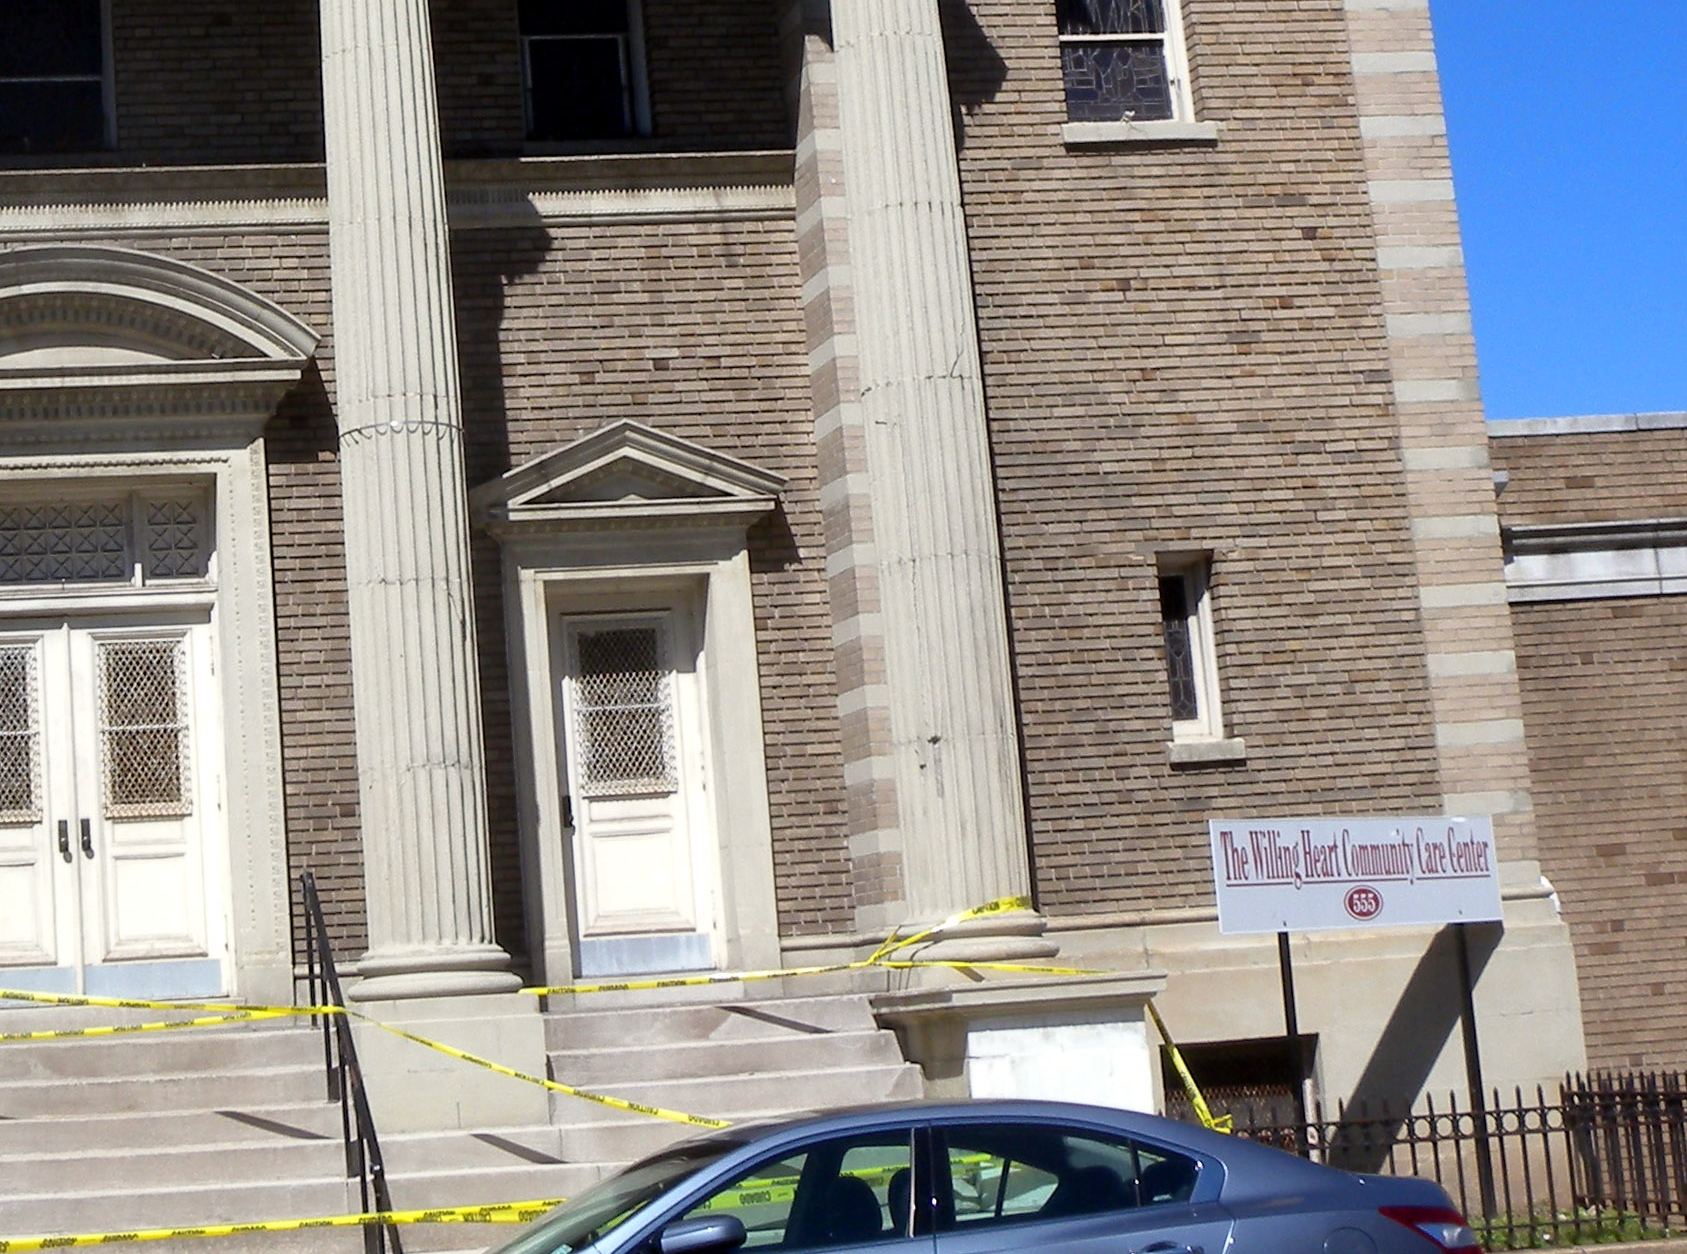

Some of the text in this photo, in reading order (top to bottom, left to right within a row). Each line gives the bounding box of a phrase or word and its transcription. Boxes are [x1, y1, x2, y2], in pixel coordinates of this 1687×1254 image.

[1220, 826, 1491, 890] The Willing Heart Community Care Center
[1353, 894, 1376, 913] 555
